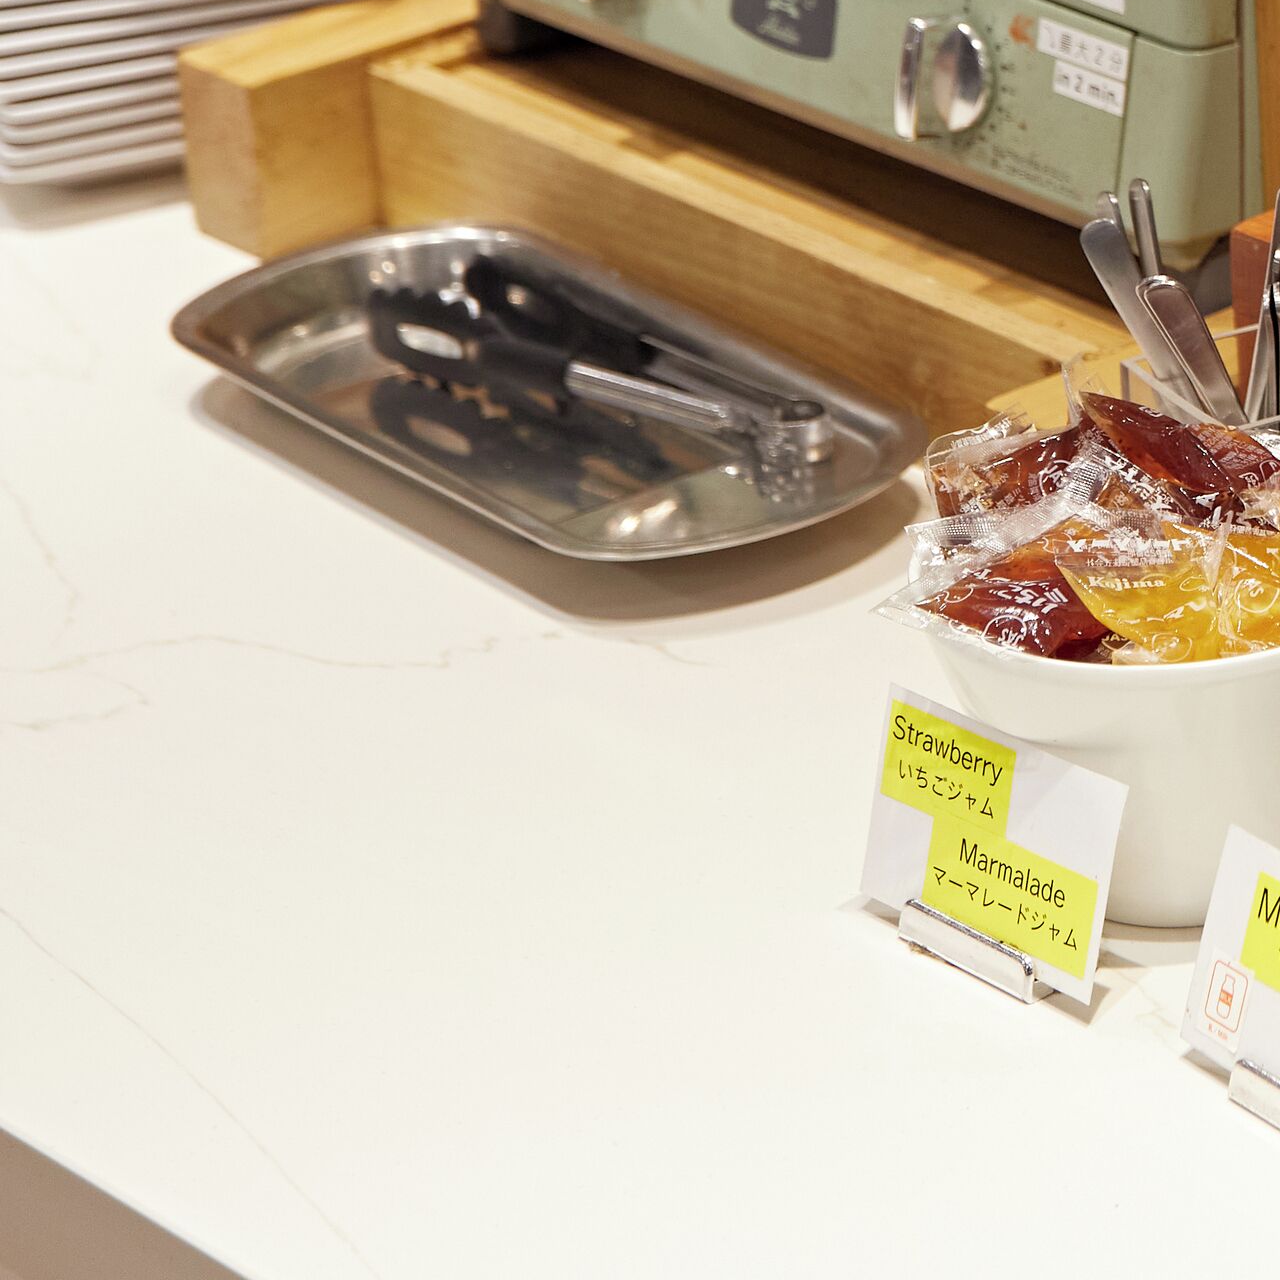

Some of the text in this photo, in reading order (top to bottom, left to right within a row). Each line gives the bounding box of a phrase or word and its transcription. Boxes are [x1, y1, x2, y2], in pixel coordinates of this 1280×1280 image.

[1087, 576, 1167, 591] Kojima
[892, 715, 1003, 787] Strawberry
[898, 759, 995, 820] いちごジャム
[932, 865, 1078, 951] マーマレードジャム
[959, 837, 1066, 909] Marmalade
